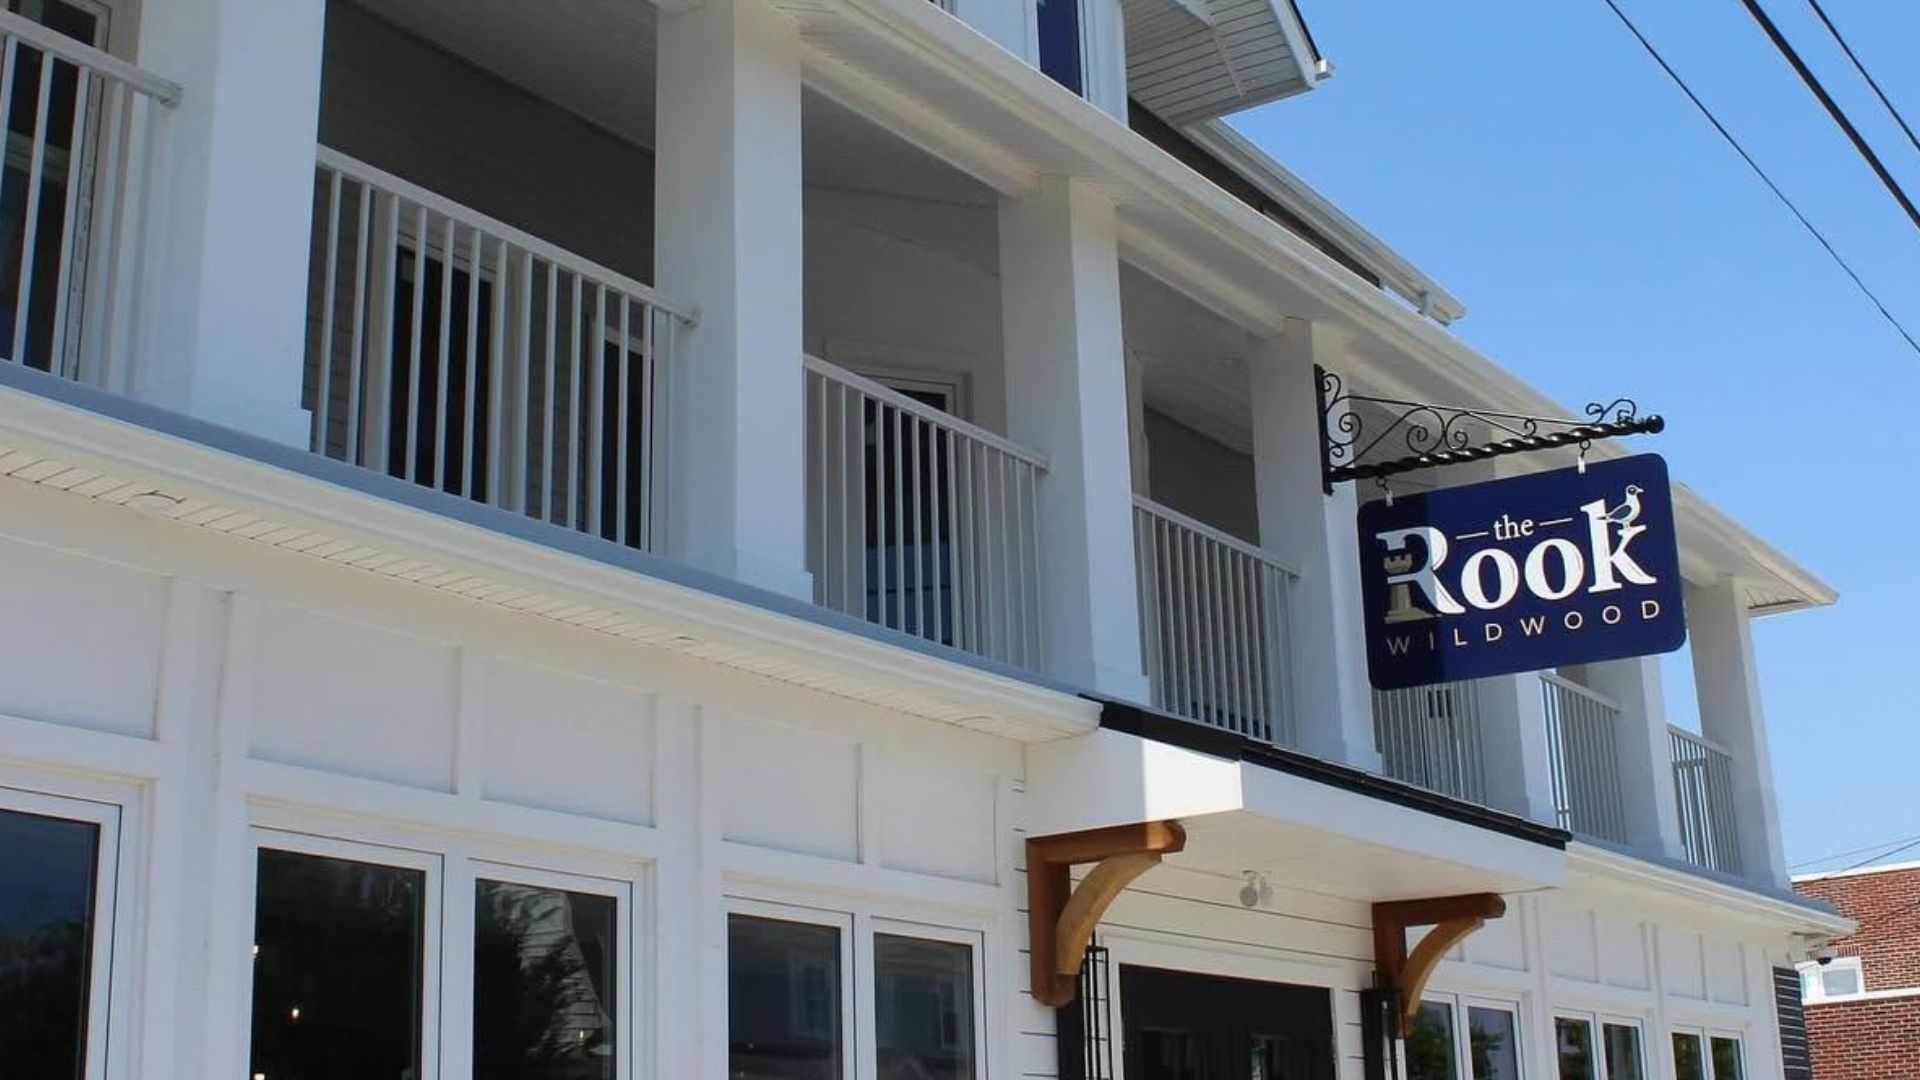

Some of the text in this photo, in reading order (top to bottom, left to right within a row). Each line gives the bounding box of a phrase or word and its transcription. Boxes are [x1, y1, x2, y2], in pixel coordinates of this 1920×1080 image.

[1493, 514, 1535, 541] the
[1376, 498, 1657, 623] Rook
[1387, 600, 1660, 655] WILDWOOD
